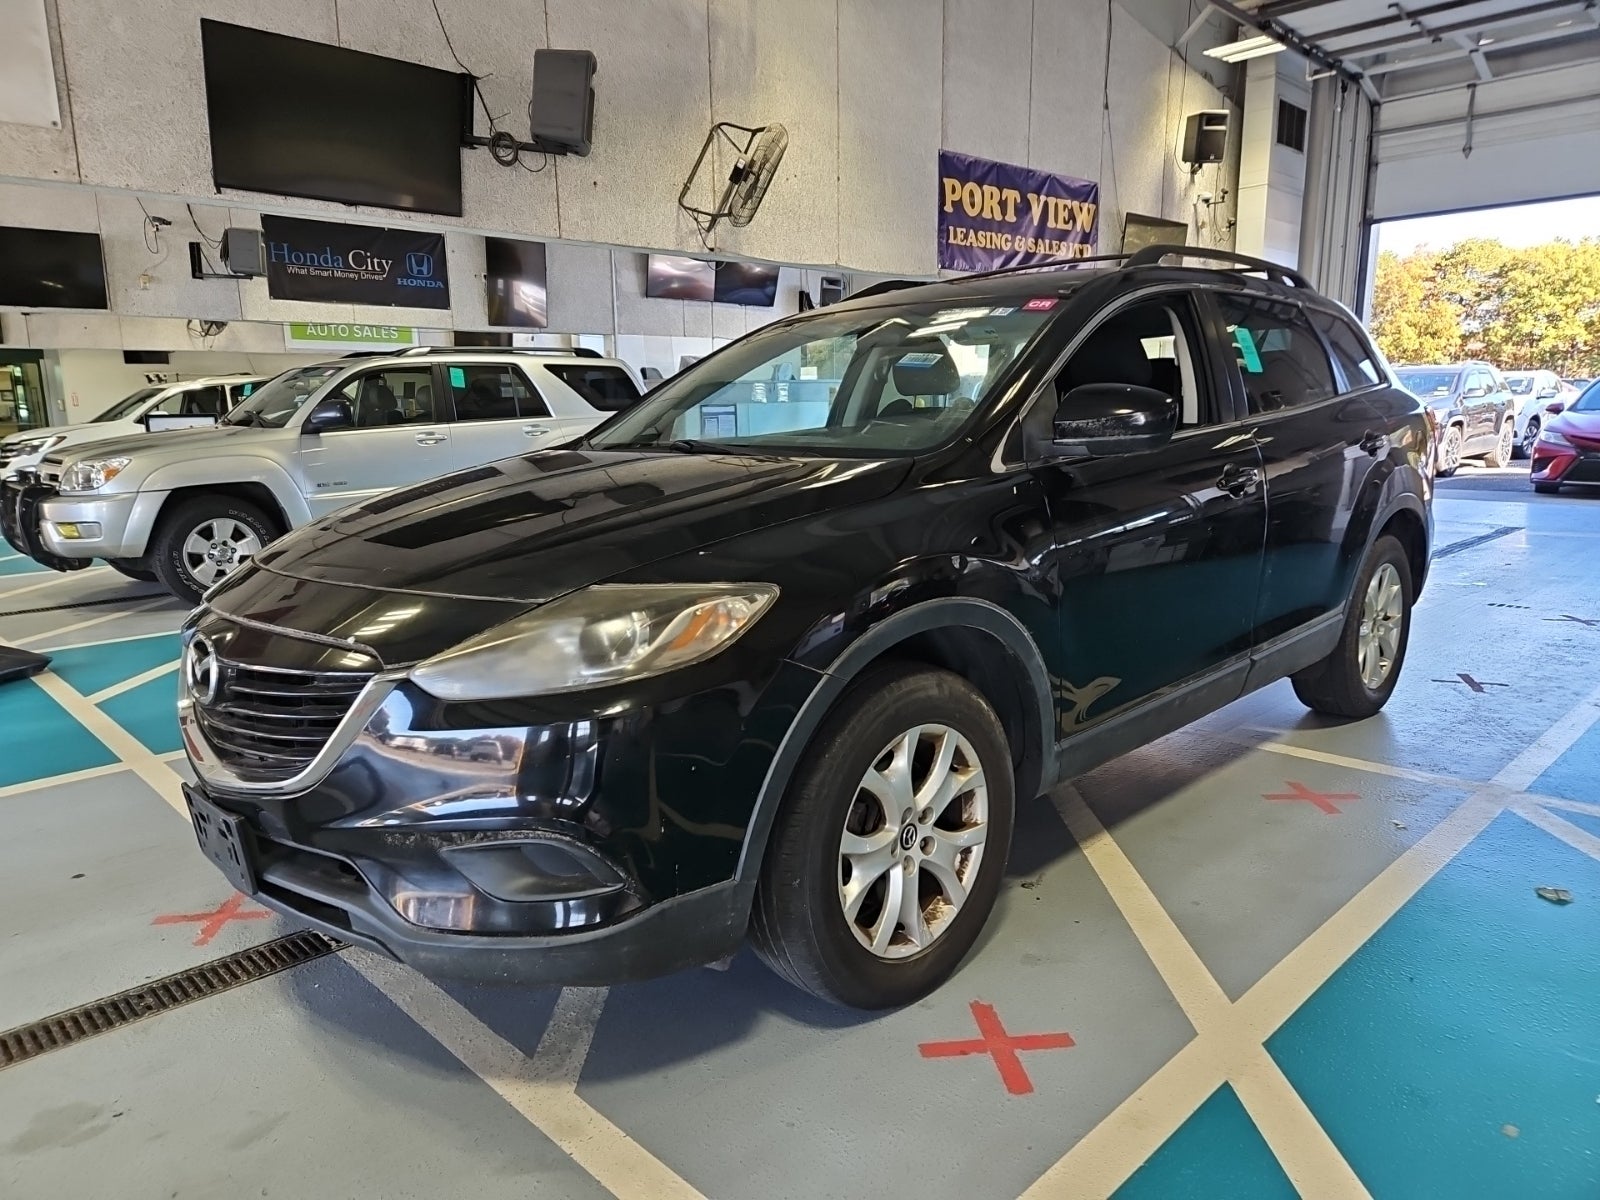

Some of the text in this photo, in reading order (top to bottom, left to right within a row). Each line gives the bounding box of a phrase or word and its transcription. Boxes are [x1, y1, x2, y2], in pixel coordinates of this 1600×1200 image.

[943, 177, 1096, 233] PORT VIEW
[948, 226, 1012, 251] LEASING
[1015, 235, 1026, 252] &
[1027, 237, 1067, 258] SALES
[269, 241, 393, 278] Honda City
[286, 266, 384, 281] What Smart Money Drives
[396, 277, 445, 289] HONDA
[1028, 299, 1053, 307] CR
[306, 323, 399, 339] AUTO SALES
